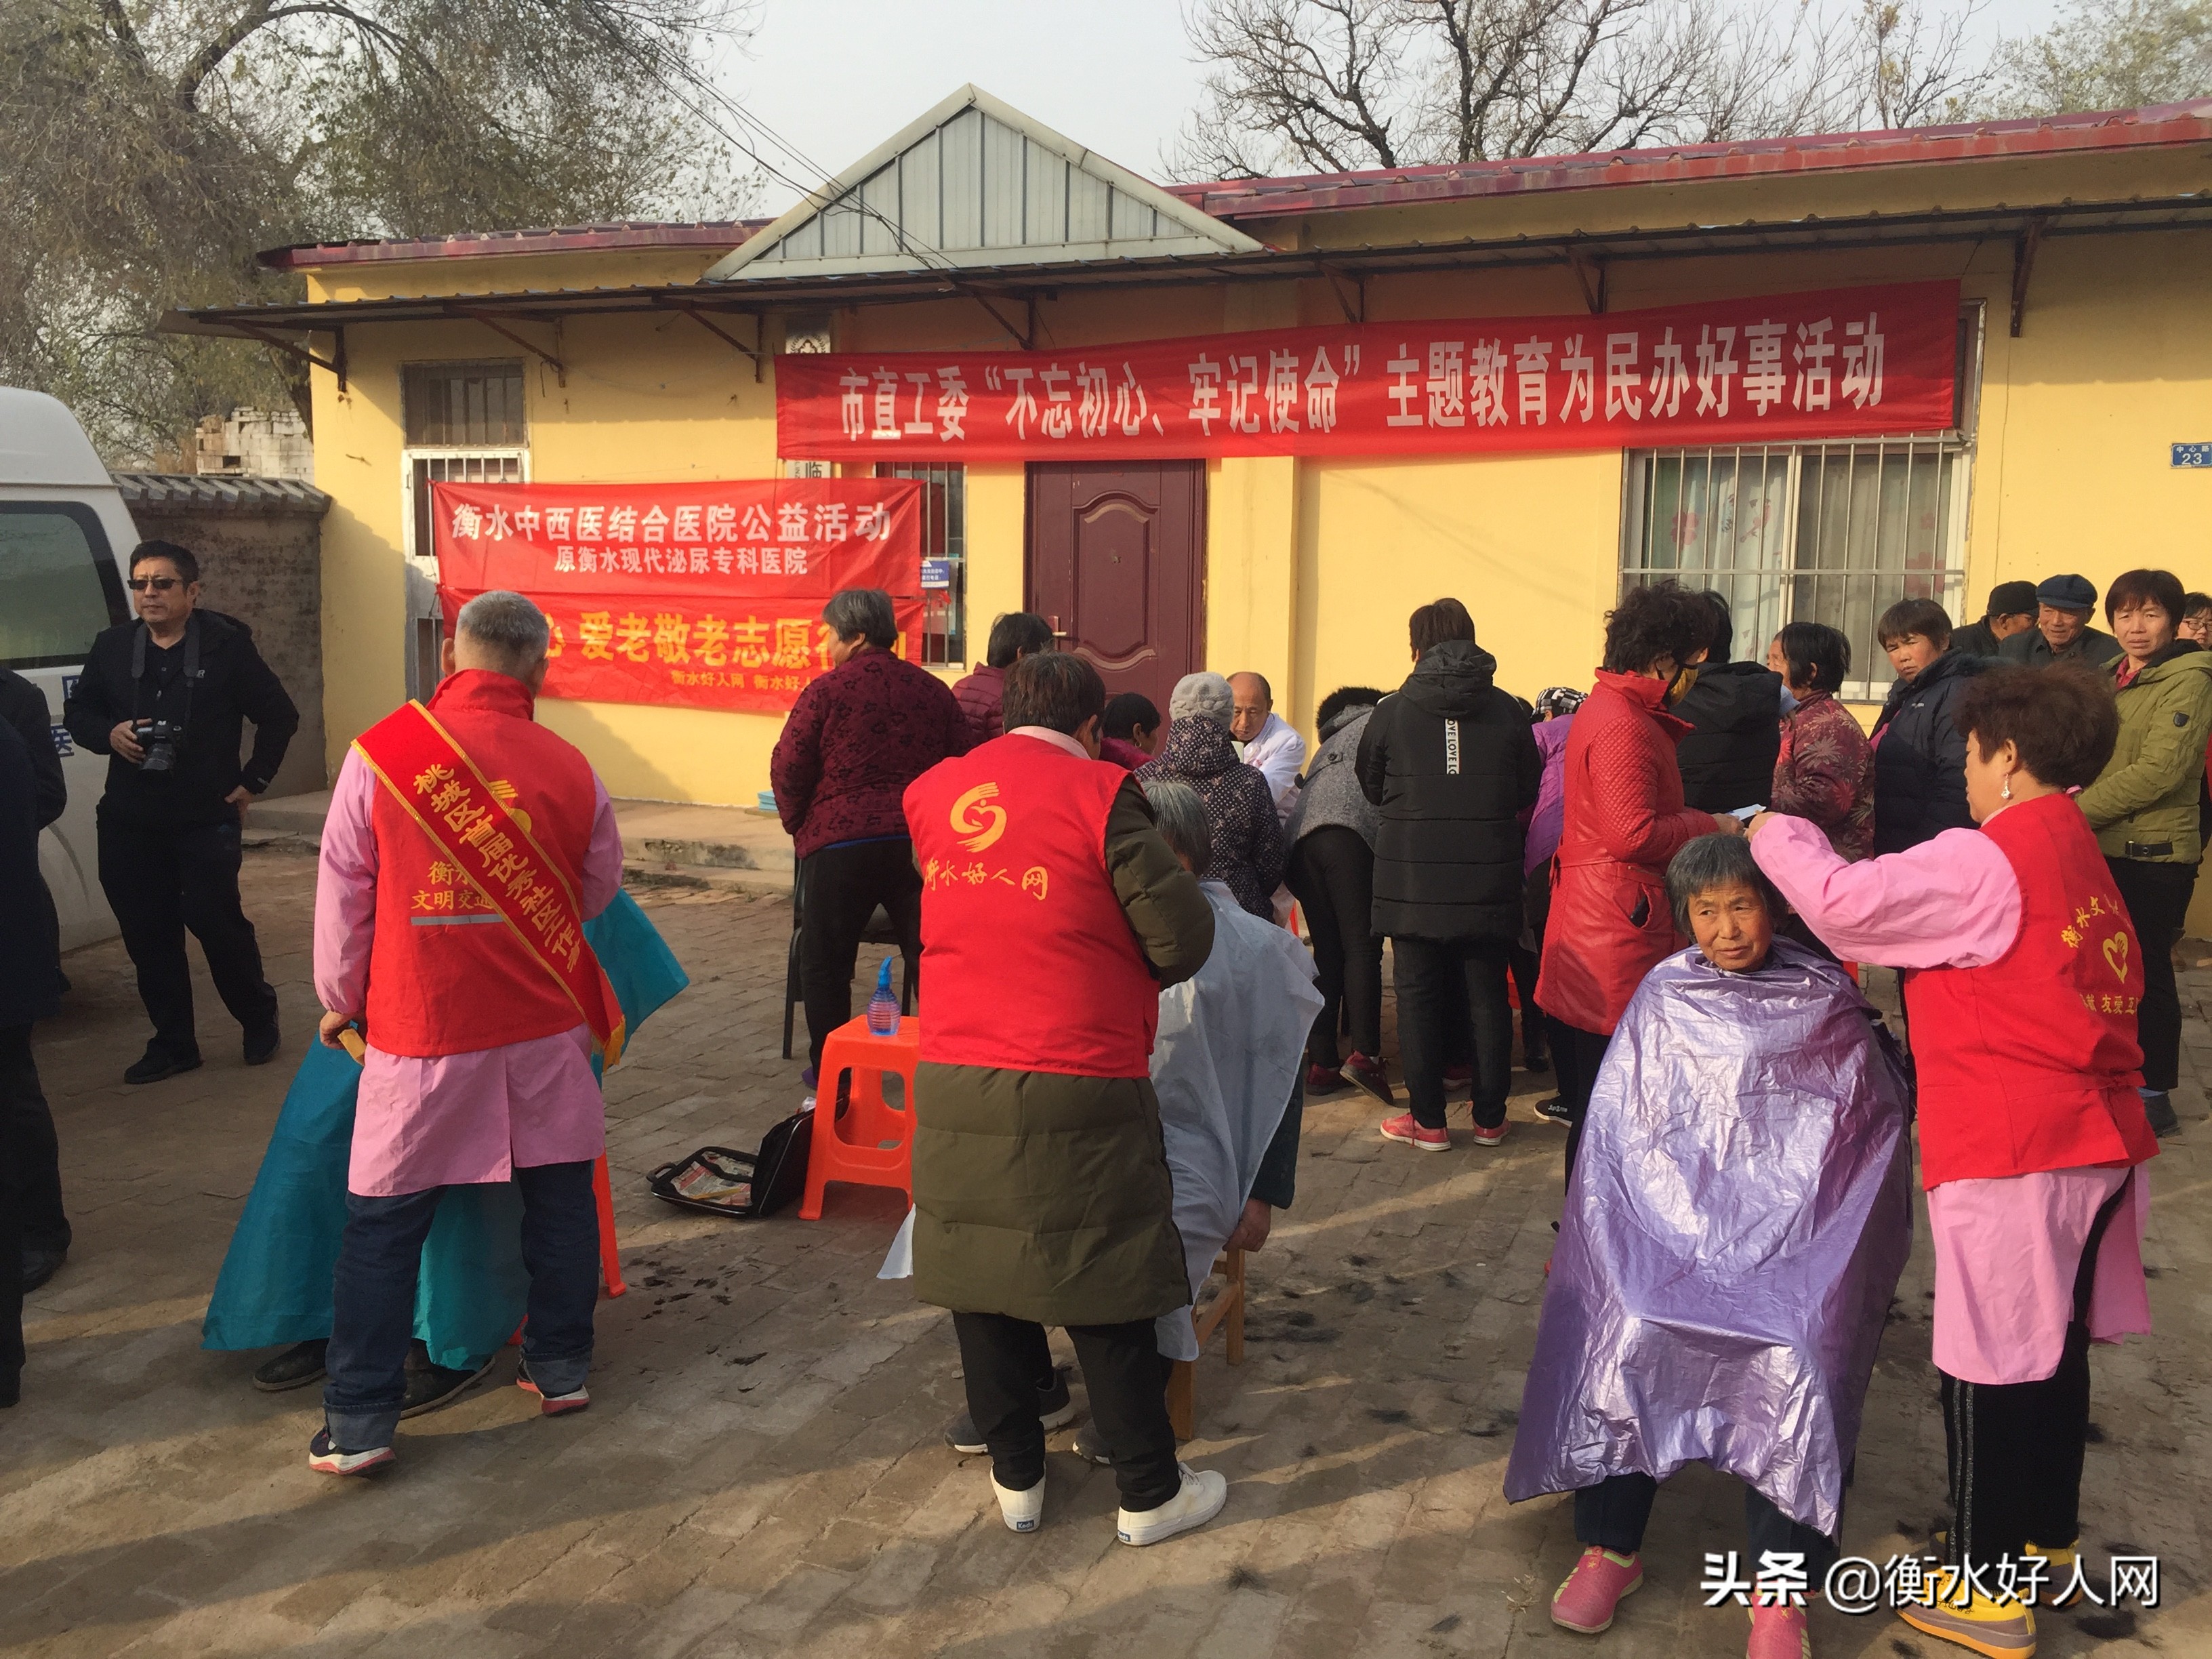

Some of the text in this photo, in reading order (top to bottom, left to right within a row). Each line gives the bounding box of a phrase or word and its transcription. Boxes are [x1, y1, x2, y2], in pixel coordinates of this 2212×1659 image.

[2182, 453, 2203, 465] 23
[452, 502, 891, 543] 衡水中西医结合医院公益活动
[554, 544, 808, 575] 原衡水现代泌尿专科医院
[579, 611, 907, 671] 爱老敬老志愿
[671, 669, 745, 689] 衡水好人网
[1448, 739, 1457, 762] LOVE
